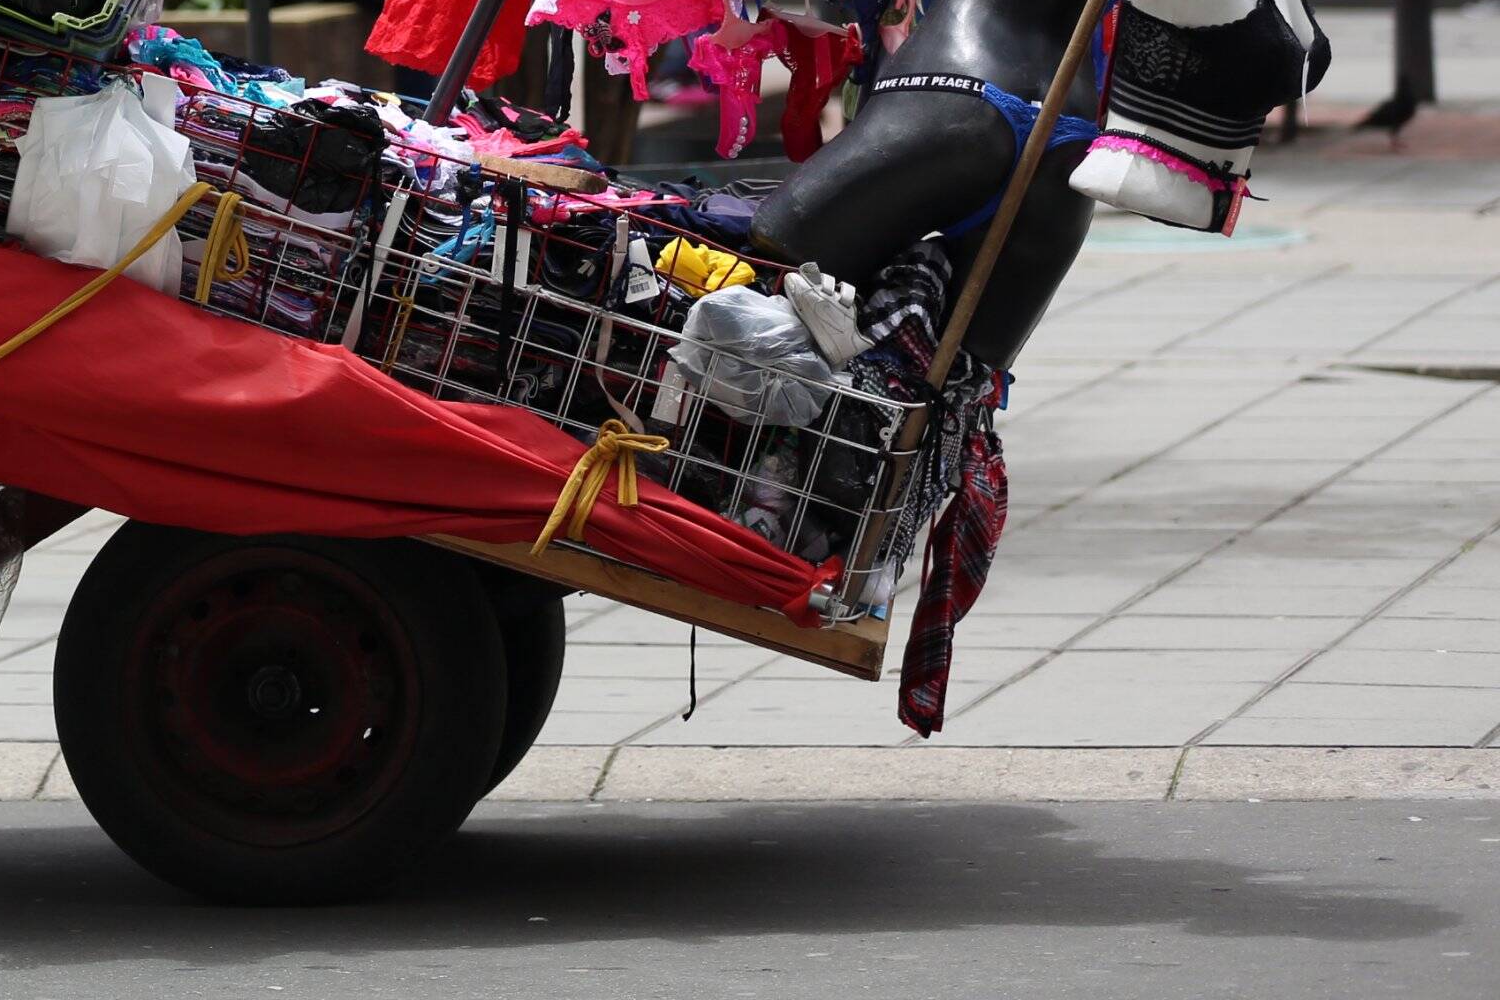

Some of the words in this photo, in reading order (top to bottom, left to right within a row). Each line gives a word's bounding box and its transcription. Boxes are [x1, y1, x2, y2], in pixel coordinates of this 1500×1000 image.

[874, 78, 899, 91] LOVE
[898, 76, 929, 87] FLIRT
[930, 76, 972, 90] PEACE
